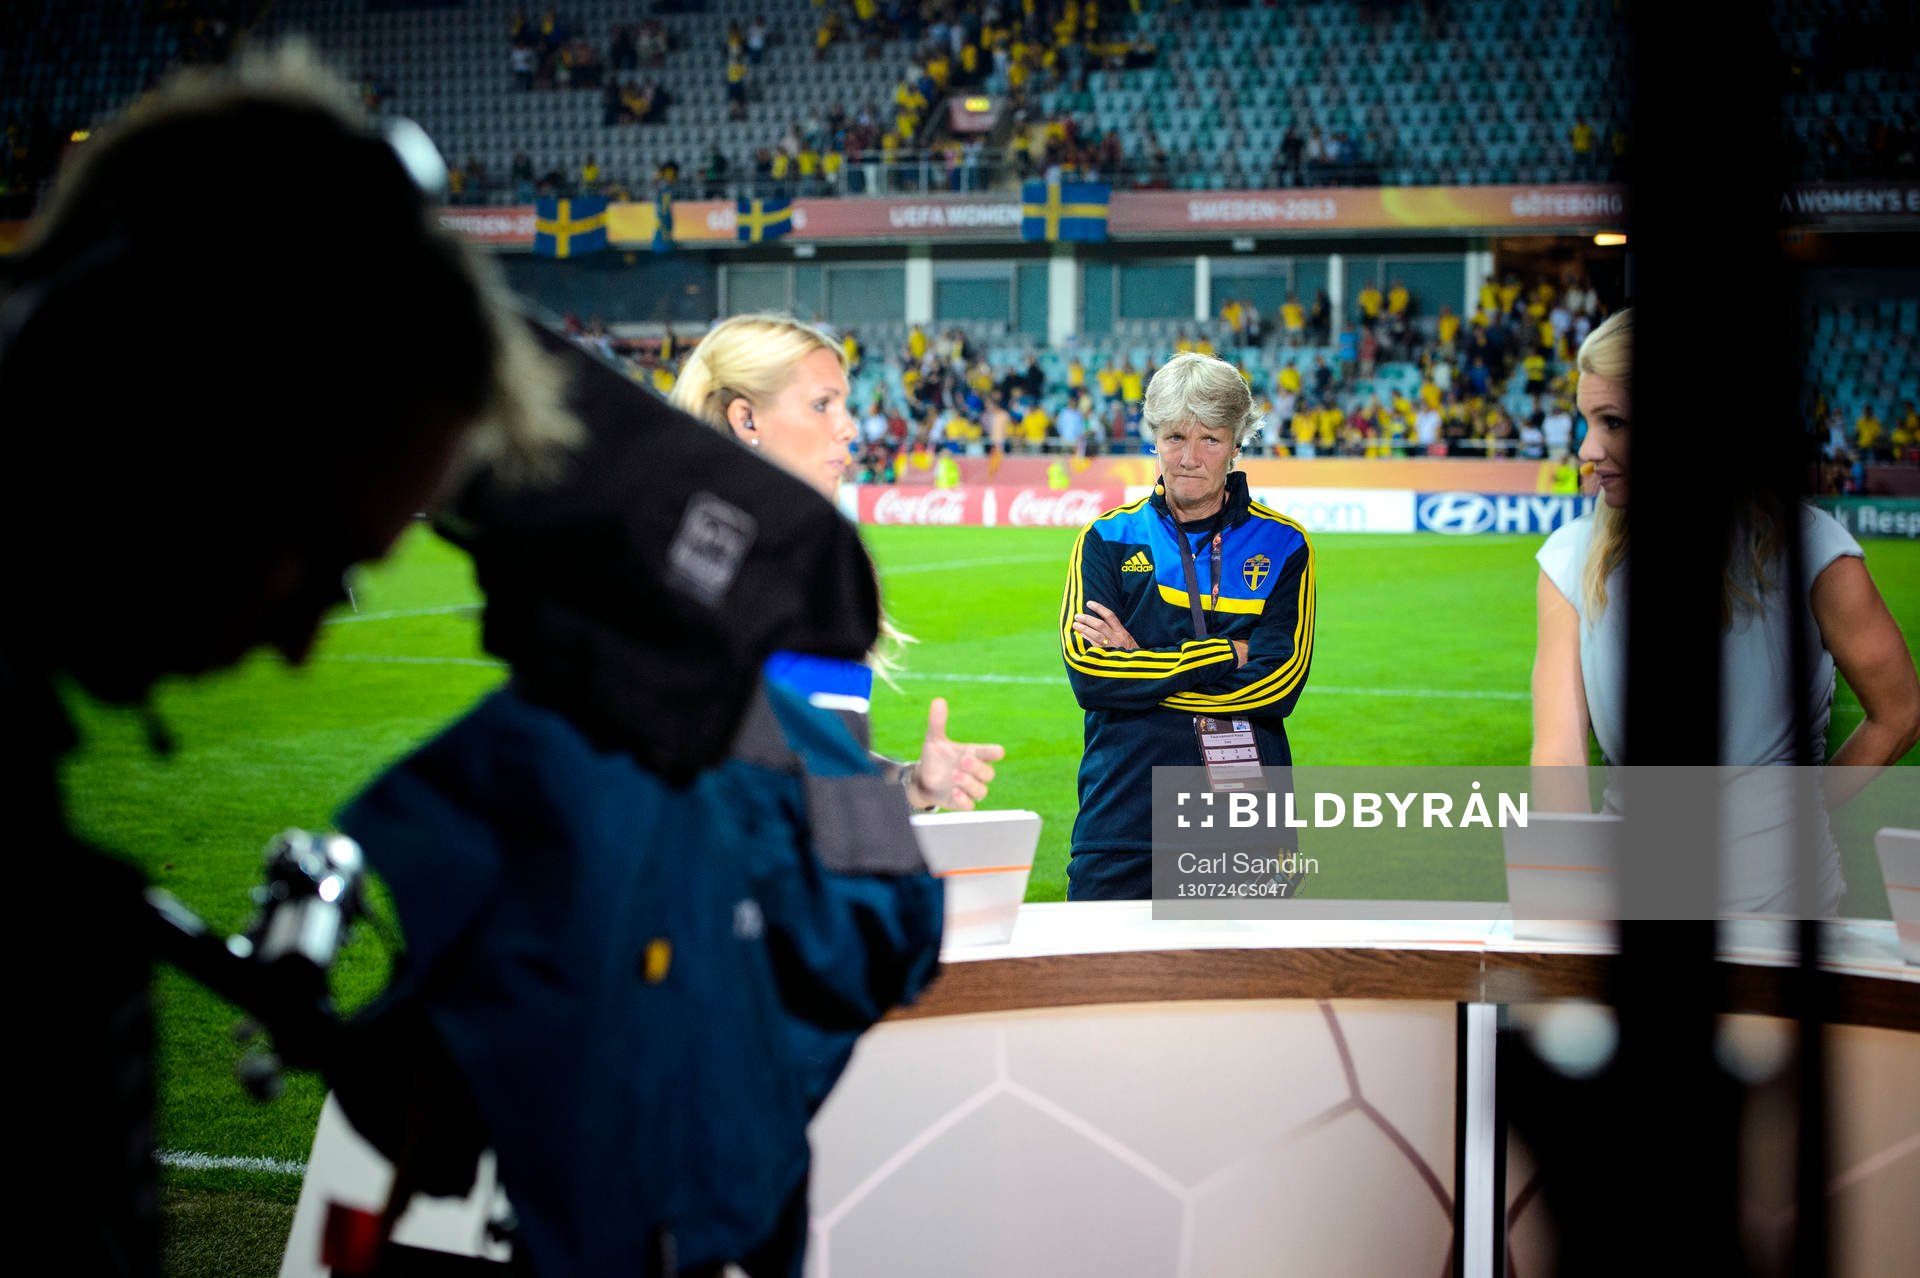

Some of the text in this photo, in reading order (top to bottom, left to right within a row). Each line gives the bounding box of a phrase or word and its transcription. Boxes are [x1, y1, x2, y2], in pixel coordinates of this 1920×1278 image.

[889, 205, 943, 228] UEFA
[1188, 198, 1337, 222] SWEDEN-2013
[873, 489, 967, 525] Coca-Cola
[1121, 563, 1153, 573] adidas
